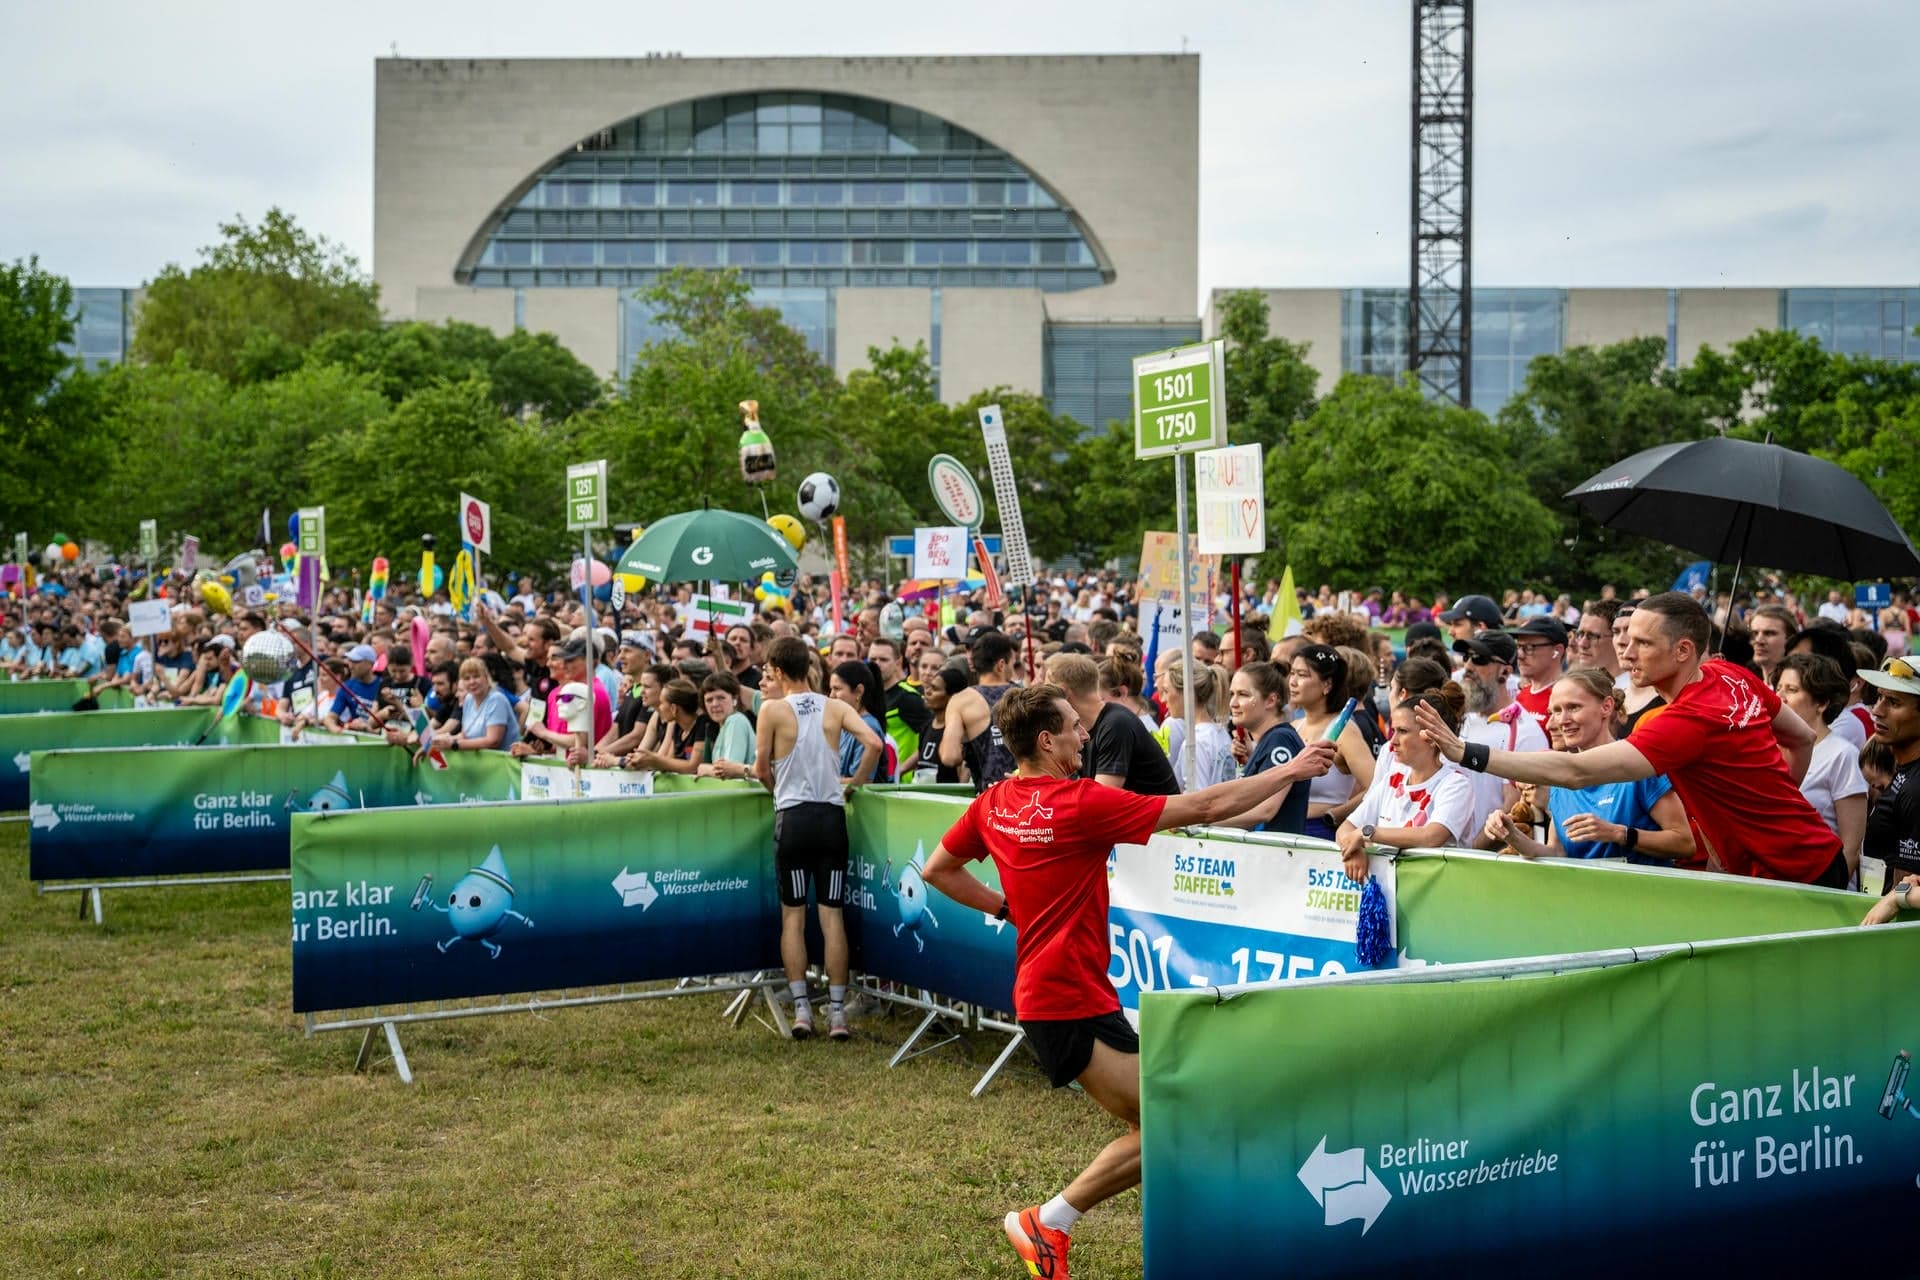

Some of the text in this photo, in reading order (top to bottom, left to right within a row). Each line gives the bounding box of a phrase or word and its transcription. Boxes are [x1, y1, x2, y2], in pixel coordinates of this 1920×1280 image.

[1153, 371, 1193, 402] 1501
[1156, 411, 1196, 441] 1750
[575, 478, 593, 497] 1251
[575, 503, 594, 521] 1500
[193, 791, 273, 810] Ganz klar
[64, 811, 135, 823] Wasserbetriebe
[193, 812, 276, 830] für Berlin.
[654, 868, 701, 883] Berliner
[1174, 854, 1236, 878] 5x5 TEAM
[662, 877, 749, 896] Wasserbetriebe
[1173, 873, 1221, 897] STAFFEL
[1308, 868, 1364, 891] 5x5 TEA
[292, 880, 394, 910] anz klar
[317, 911, 398, 940] Berlin.
[1109, 923, 1173, 992] 501
[1690, 1065, 1856, 1128] Ganz klar
[1379, 1136, 1470, 1169] Berliner
[1690, 1123, 1865, 1190] für Berlin.
[1400, 1148, 1559, 1196] Wasserbetriebe
